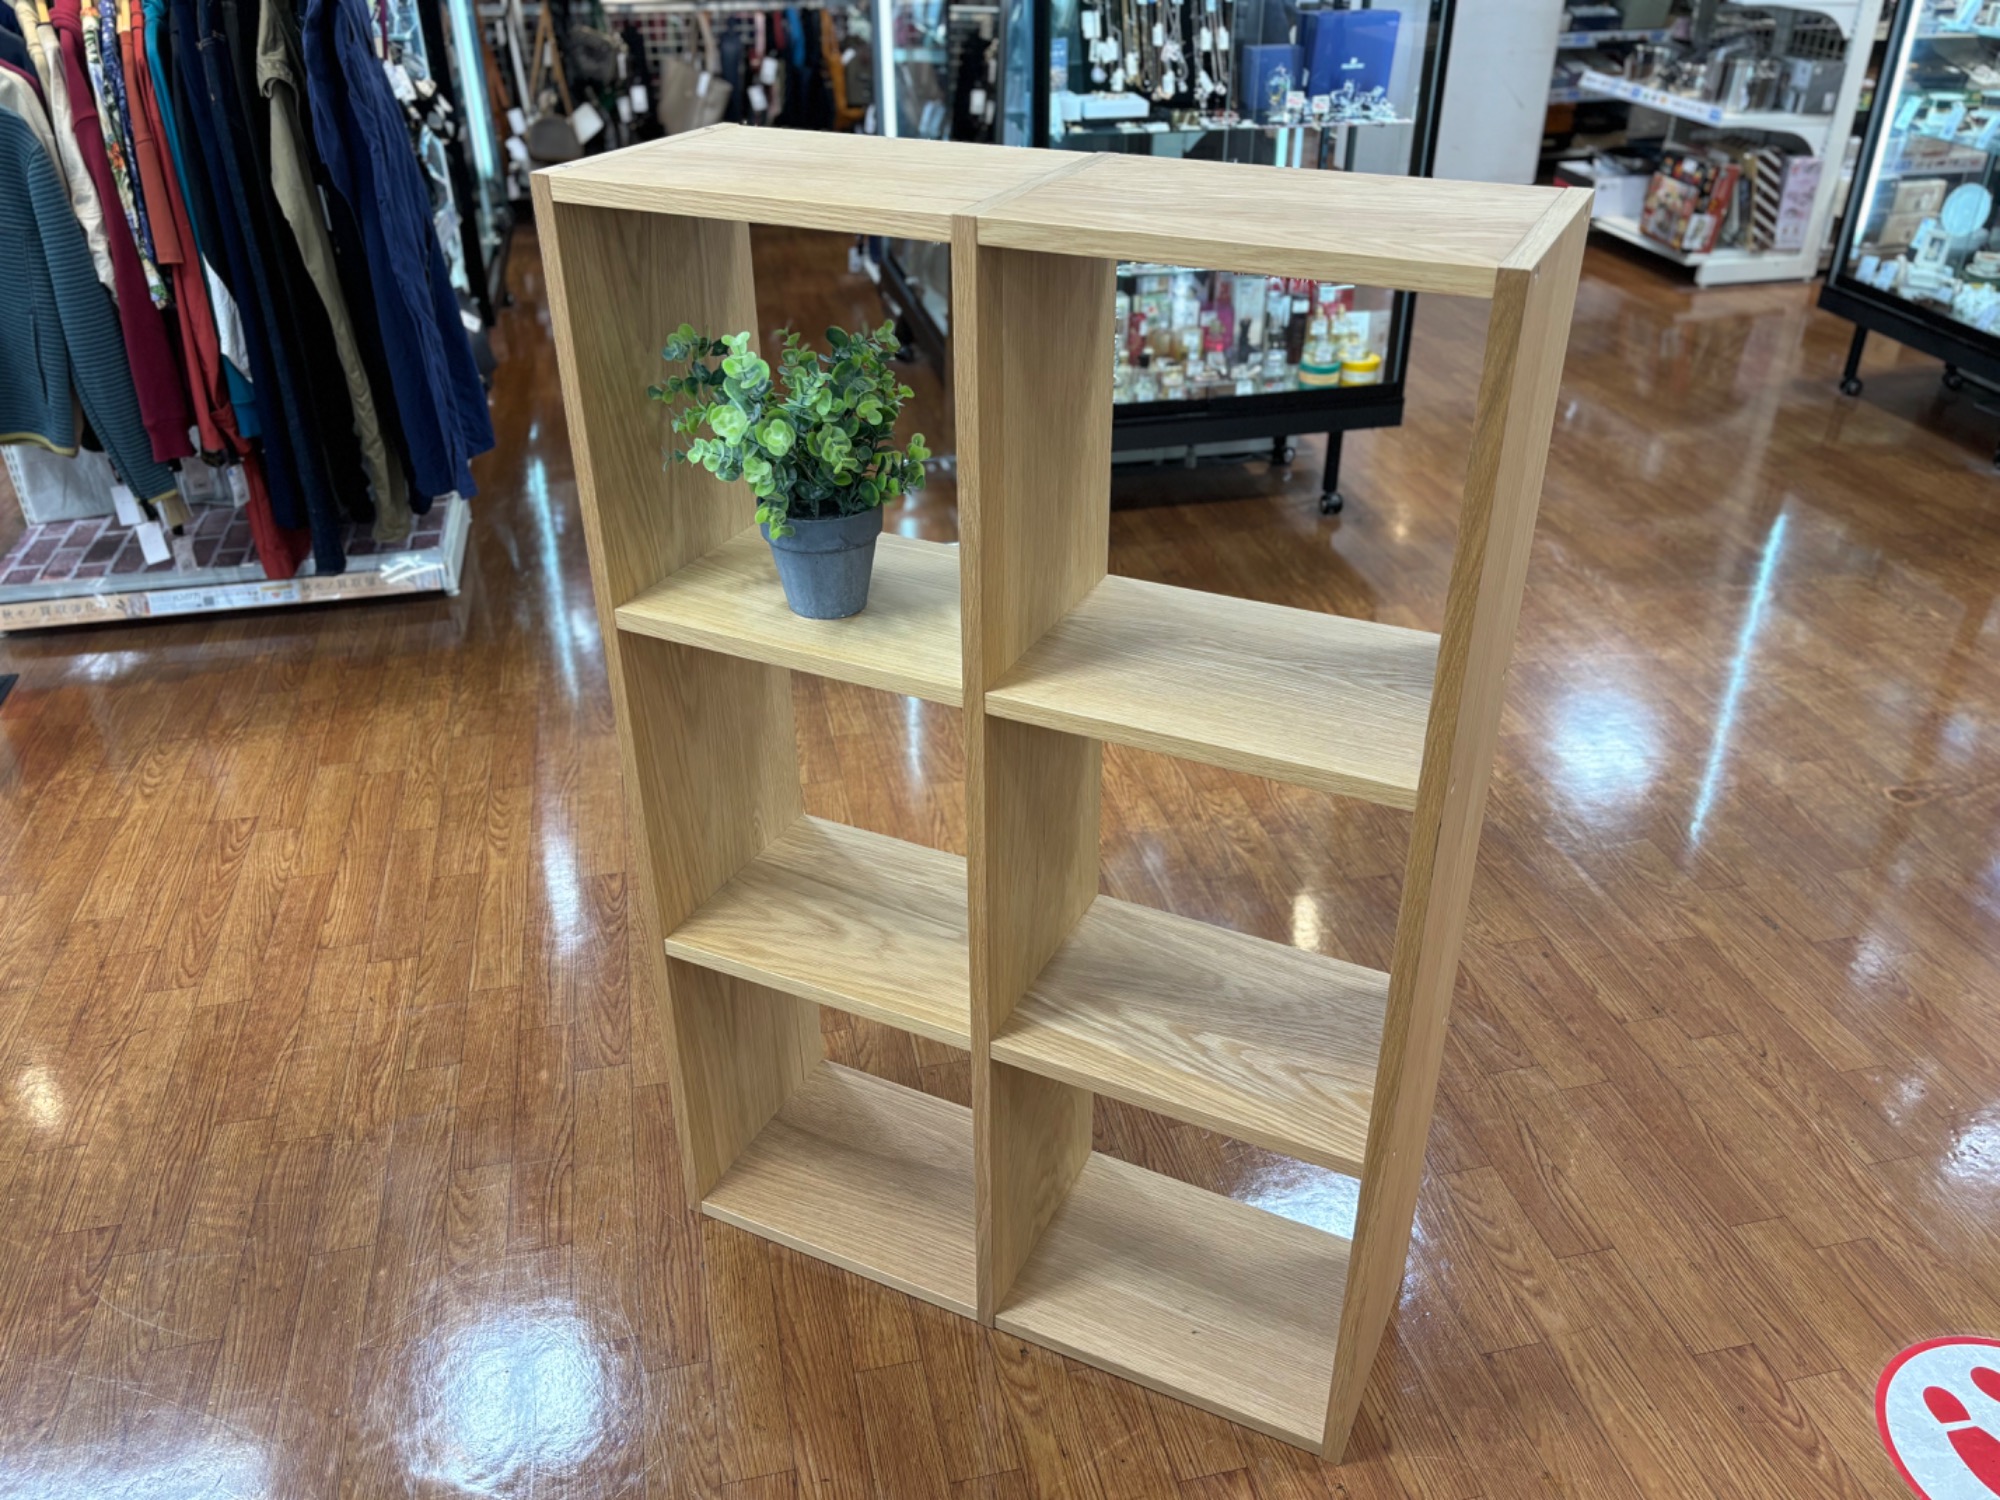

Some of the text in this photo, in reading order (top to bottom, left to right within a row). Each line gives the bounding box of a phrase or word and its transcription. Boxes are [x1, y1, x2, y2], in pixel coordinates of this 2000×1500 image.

[2, 600, 110, 619] 秋モノ買取強化
